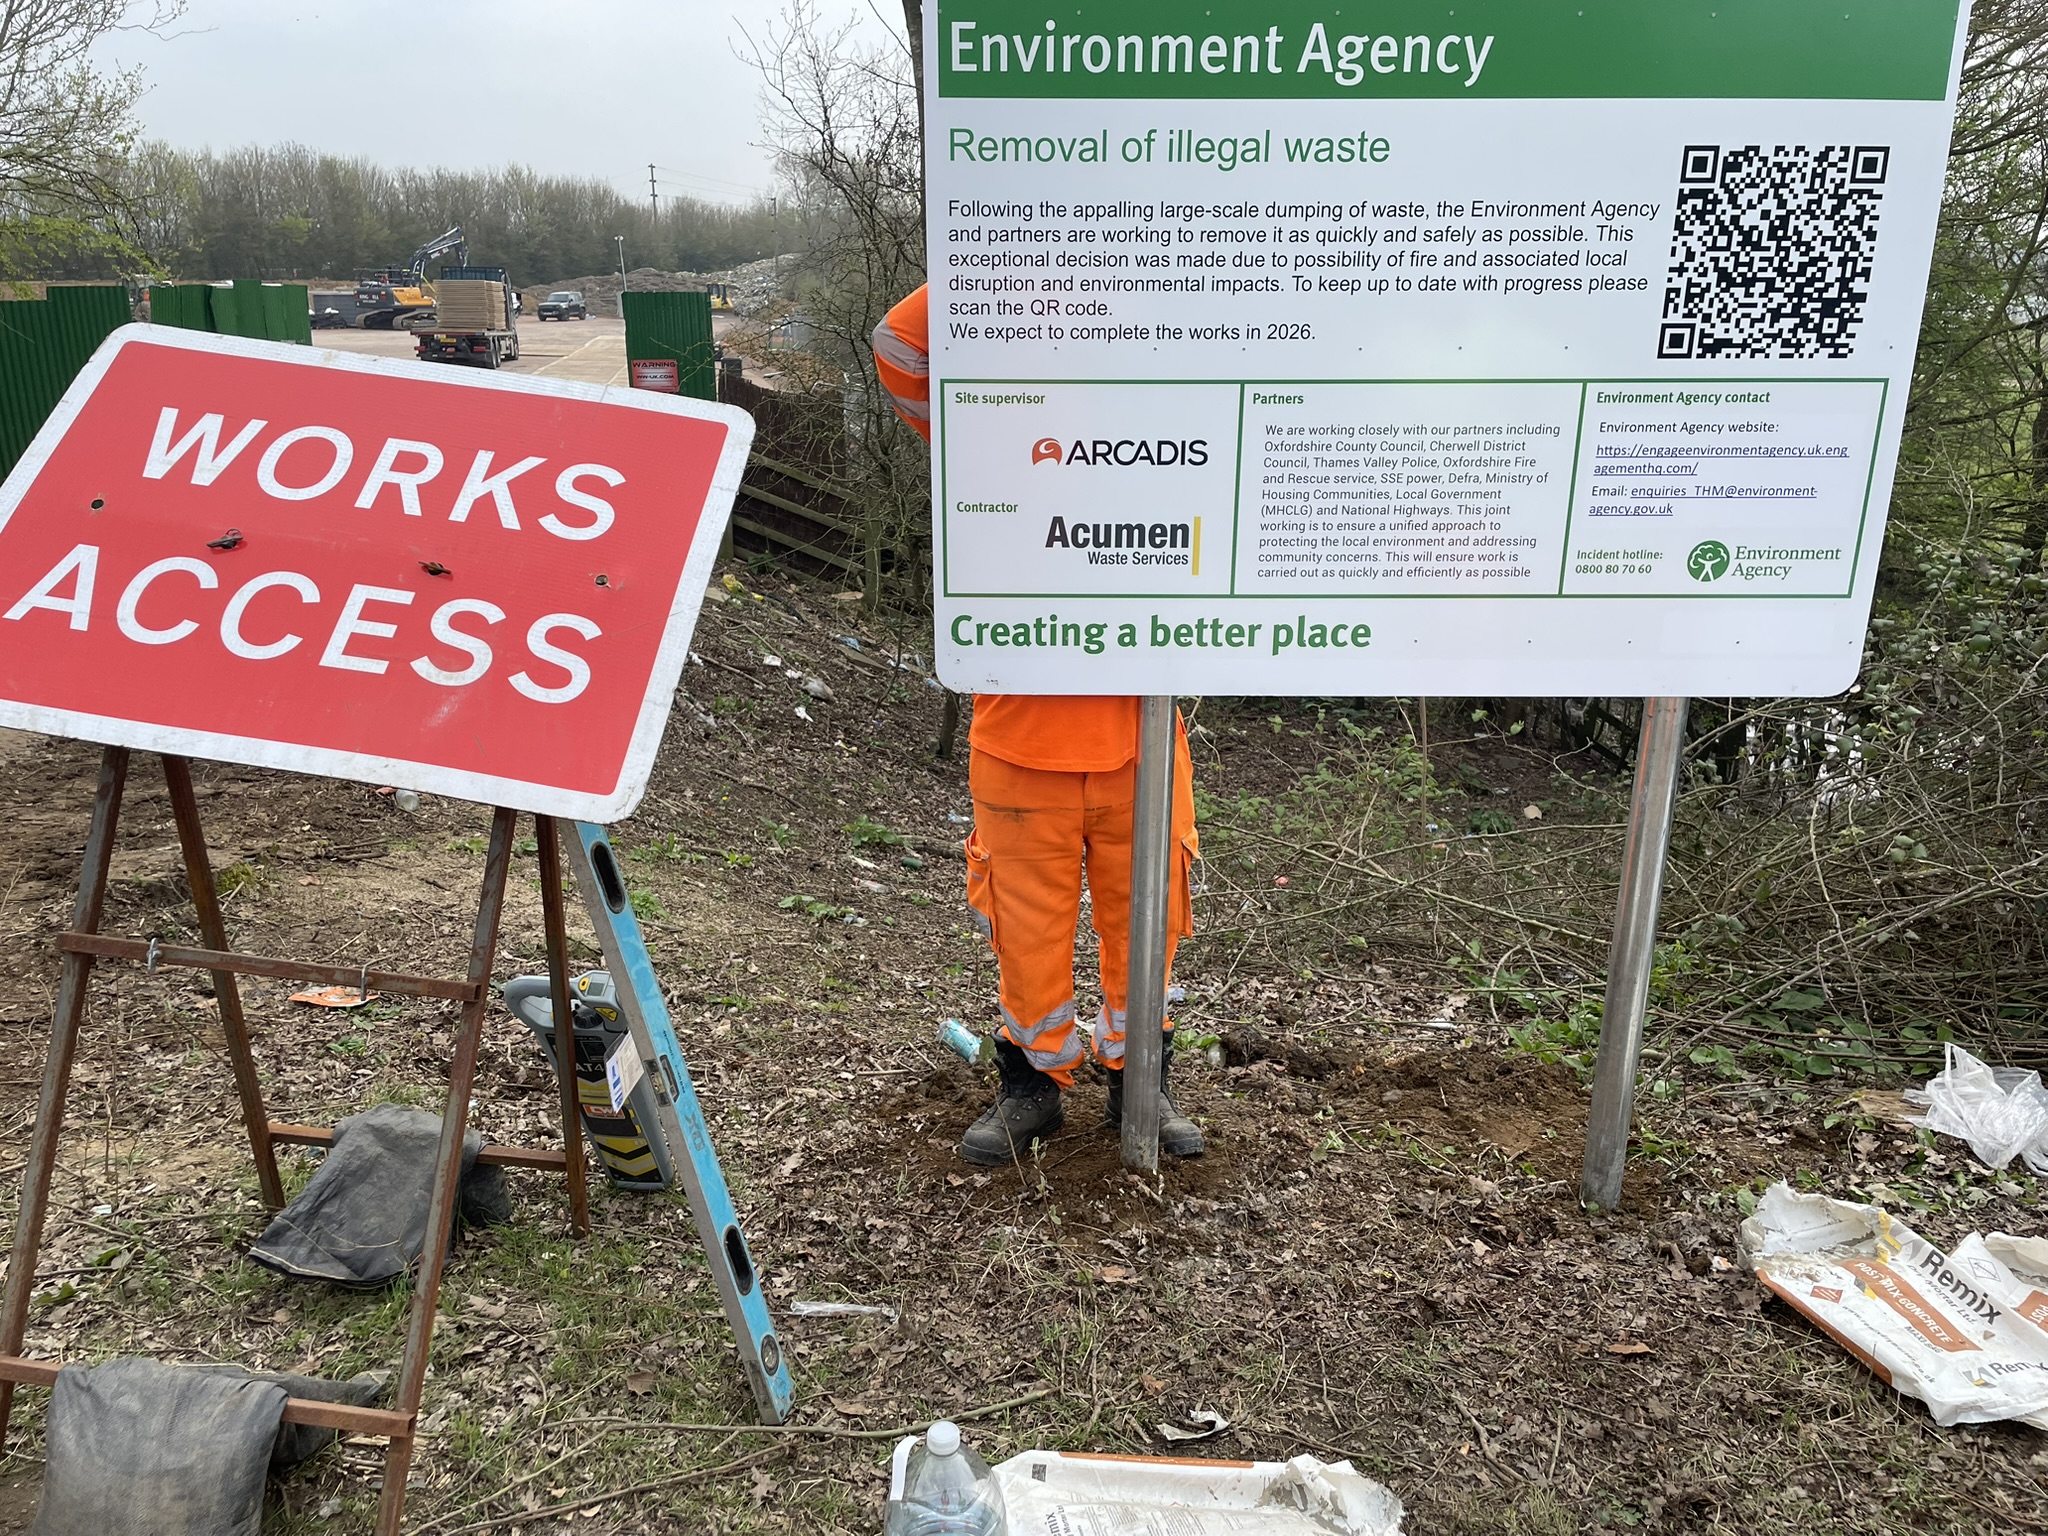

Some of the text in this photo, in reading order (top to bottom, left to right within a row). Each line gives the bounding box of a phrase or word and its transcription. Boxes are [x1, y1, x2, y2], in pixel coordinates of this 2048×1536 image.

[952, 20, 1494, 87] Environment Agency
[950, 128, 1390, 171] Removal of illegal waste
[949, 200, 1661, 223] Following the appalling large-scale dumping of waste, the Environment Agency
[948, 225, 1634, 247] and partners are working to remove it as quickly and safely as possible. This
[949, 274, 1648, 296] disruption and environmental impacts. To keep up to date with progress please
[949, 322, 1315, 344] We expect to complete the works in 2026.
[955, 392, 1046, 407] Site supervisor
[1253, 393, 1304, 405] Partners
[1597, 391, 1771, 406] Environment Agency contact
[1265, 423, 1560, 438] We are working closely with our partners including
[1599, 421, 1779, 435] Environment Agency website:
[1065, 439, 1208, 466] ARCADIS
[1264, 440, 1526, 454] Oxfordshire County Council, Cherwell District
[1263, 456, 1536, 470] Council, Thames Valley Police, Oxfordshire Fire
[1593, 461, 1699, 476] agementhq.com/
[142, 407, 626, 541] WORKS
[1262, 472, 1549, 486] and Rescue service, SSE power, Defra, Ministry of
[1262, 488, 1502, 502] Housing Communities, Local Government
[1592, 485, 1628, 497] Email:
[956, 501, 1018, 513] Contractor
[1261, 504, 1511, 518] (MHCLG) and National Highways. This joint
[1588, 503, 1674, 517] agency.gov.uk
[1045, 516, 1189, 549] Acumen
[1259, 535, 1537, 549] protecting the local environment and addressing
[1087, 551, 1189, 565] Waste Services
[1577, 549, 1663, 560] Incident hotline:
[1734, 545, 1842, 560] Environment
[1257, 566, 1531, 580] carried out as quickly and efficiently as possible
[1575, 564, 1652, 574] 0800 80 70 60
[1731, 562, 1792, 581] Agency
[2, 543, 603, 704] ACCESS
[951, 614, 1371, 656] Creating a better place
[1922, 1249, 2002, 1325] Remix
